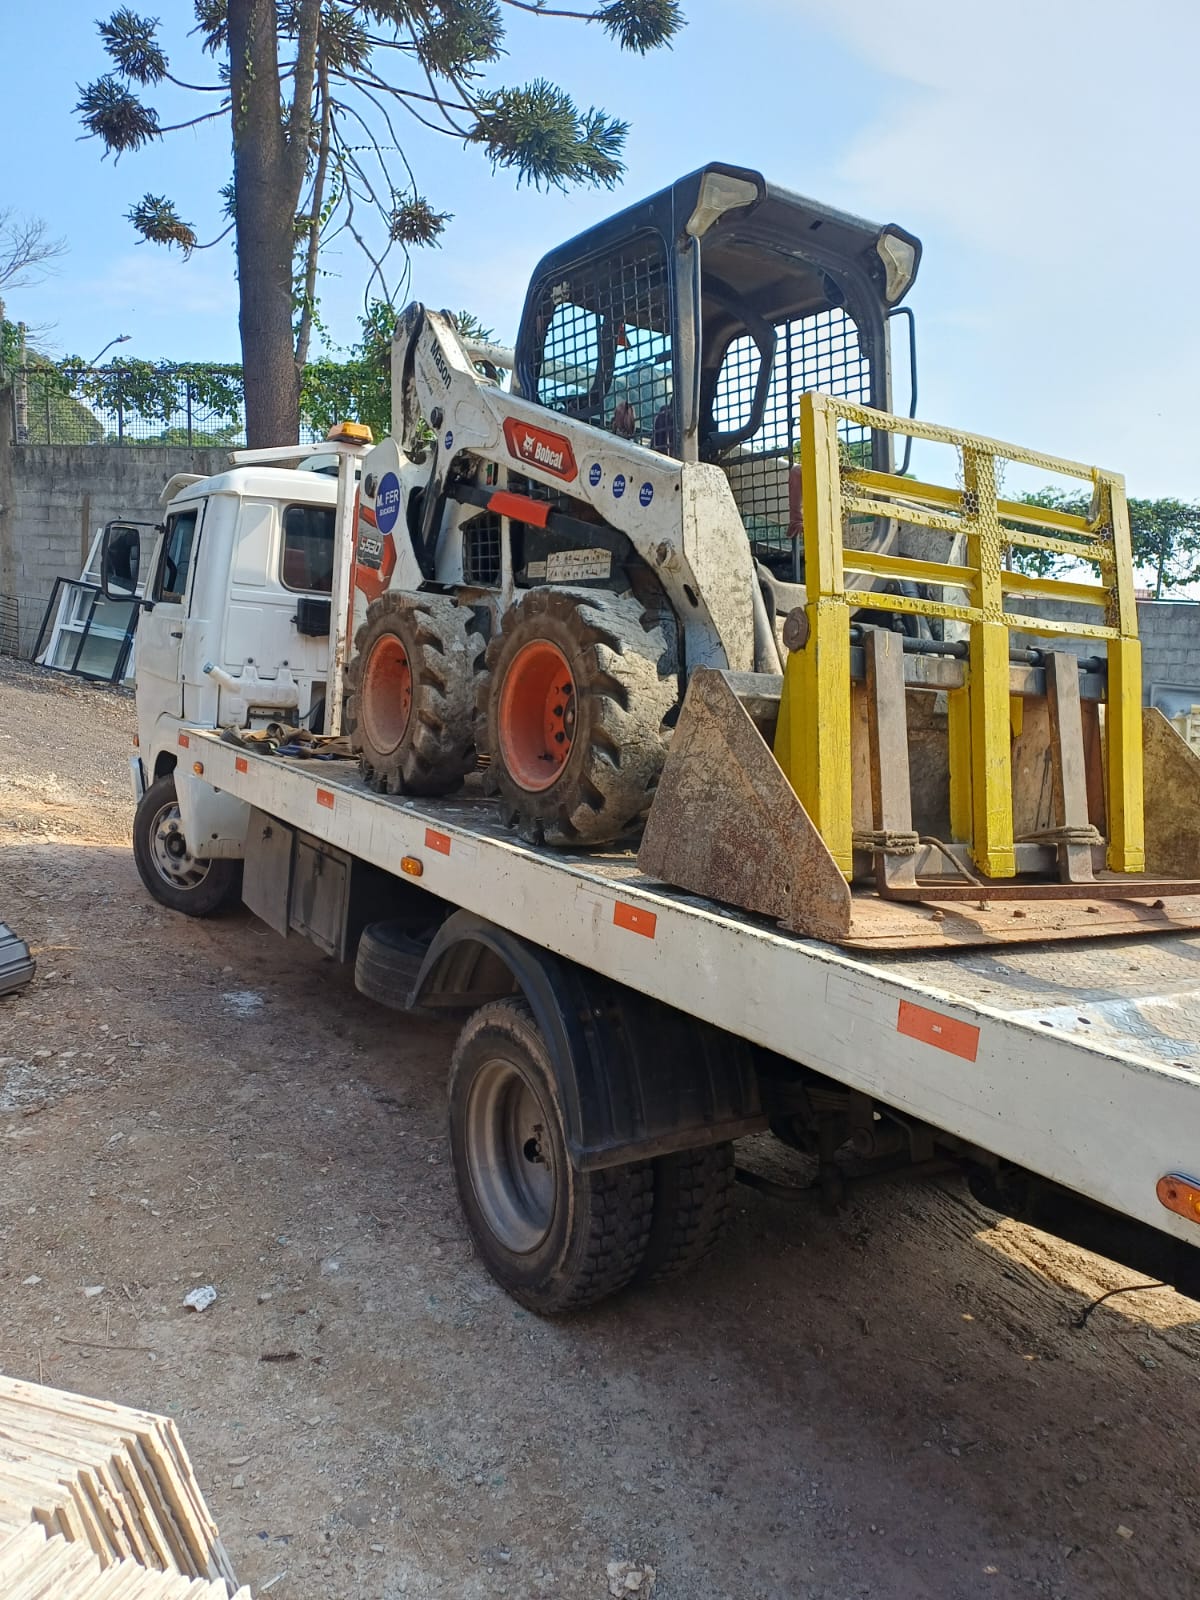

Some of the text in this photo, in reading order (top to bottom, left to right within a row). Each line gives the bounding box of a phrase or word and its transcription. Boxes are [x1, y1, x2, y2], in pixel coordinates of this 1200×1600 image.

[430, 338, 452, 390] Mason
[534, 442, 563, 469] Bobcat
[385, 489, 399, 505] FER
